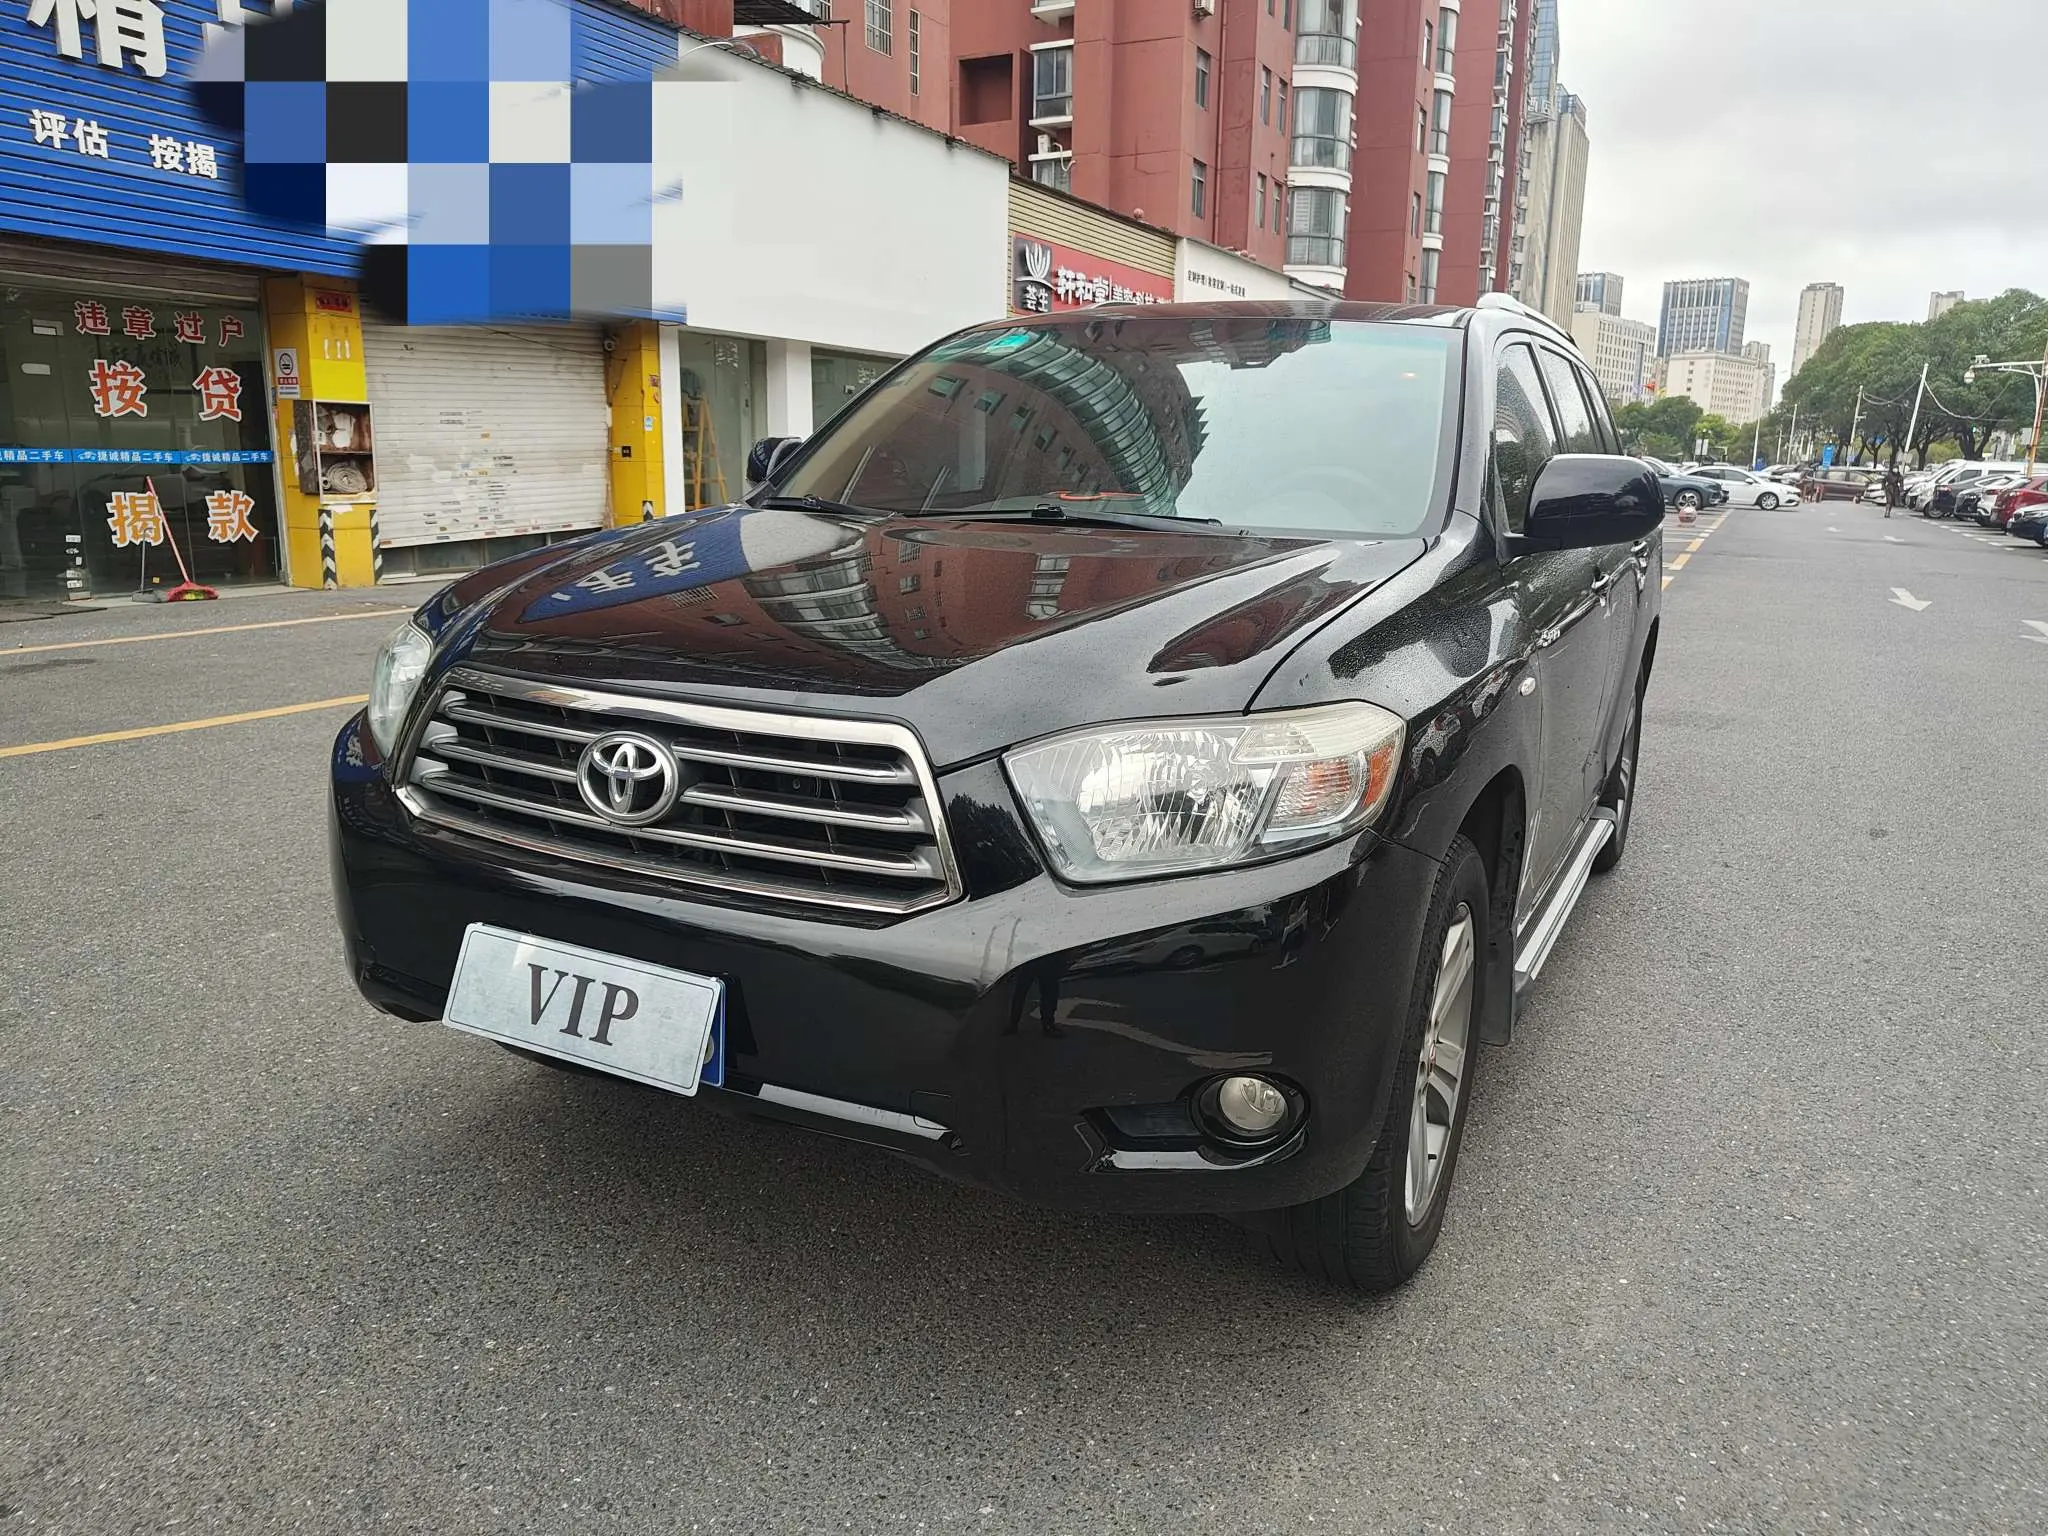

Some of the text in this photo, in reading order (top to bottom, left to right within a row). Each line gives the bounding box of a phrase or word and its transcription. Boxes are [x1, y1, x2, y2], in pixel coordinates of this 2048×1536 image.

[29, 108, 218, 179] 评估 按揭
[74, 300, 244, 347] 违章过户
[527, 962, 640, 1047] VIP
